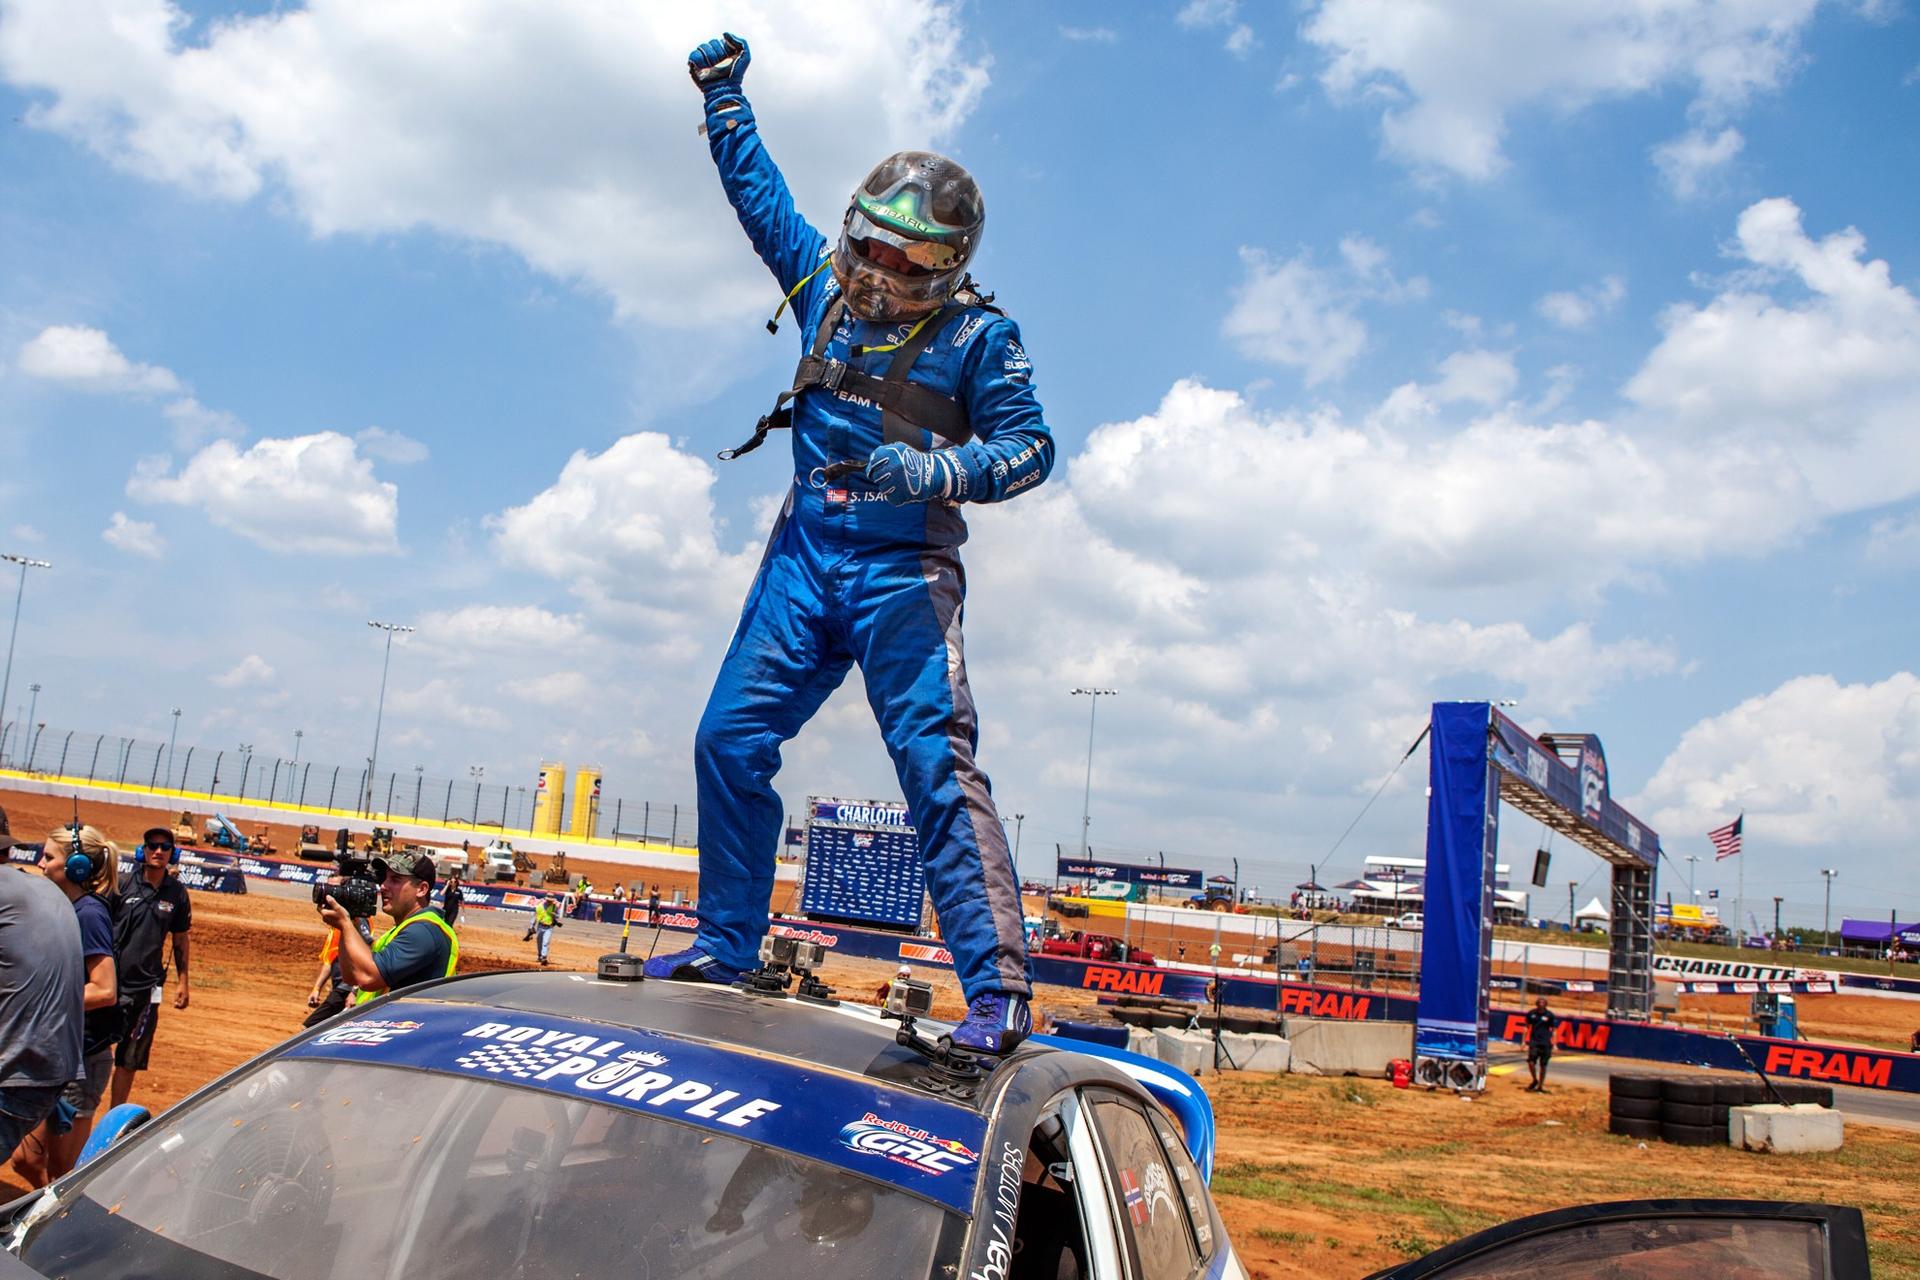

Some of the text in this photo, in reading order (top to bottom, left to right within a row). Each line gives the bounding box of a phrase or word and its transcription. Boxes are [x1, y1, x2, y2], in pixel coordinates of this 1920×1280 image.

[1004, 360, 1032, 370] SUBA
[850, 491, 861, 502] S.
[836, 805, 907, 825] CHARLOTTE
[783, 927, 837, 946] AutoZone
[1082, 966, 1165, 996] FRAM
[1653, 957, 1796, 981] CHARLOTTE
[1280, 987, 1372, 1020] FRAM
[462, 1022, 625, 1058] ROYAL
[1503, 1014, 1610, 1051] FAM
[1764, 1045, 1893, 1086] FRAM
[533, 1055, 782, 1127] PURPLE
[855, 1132, 974, 1172] GRC
[994, 1141, 1024, 1231] MOTORS
